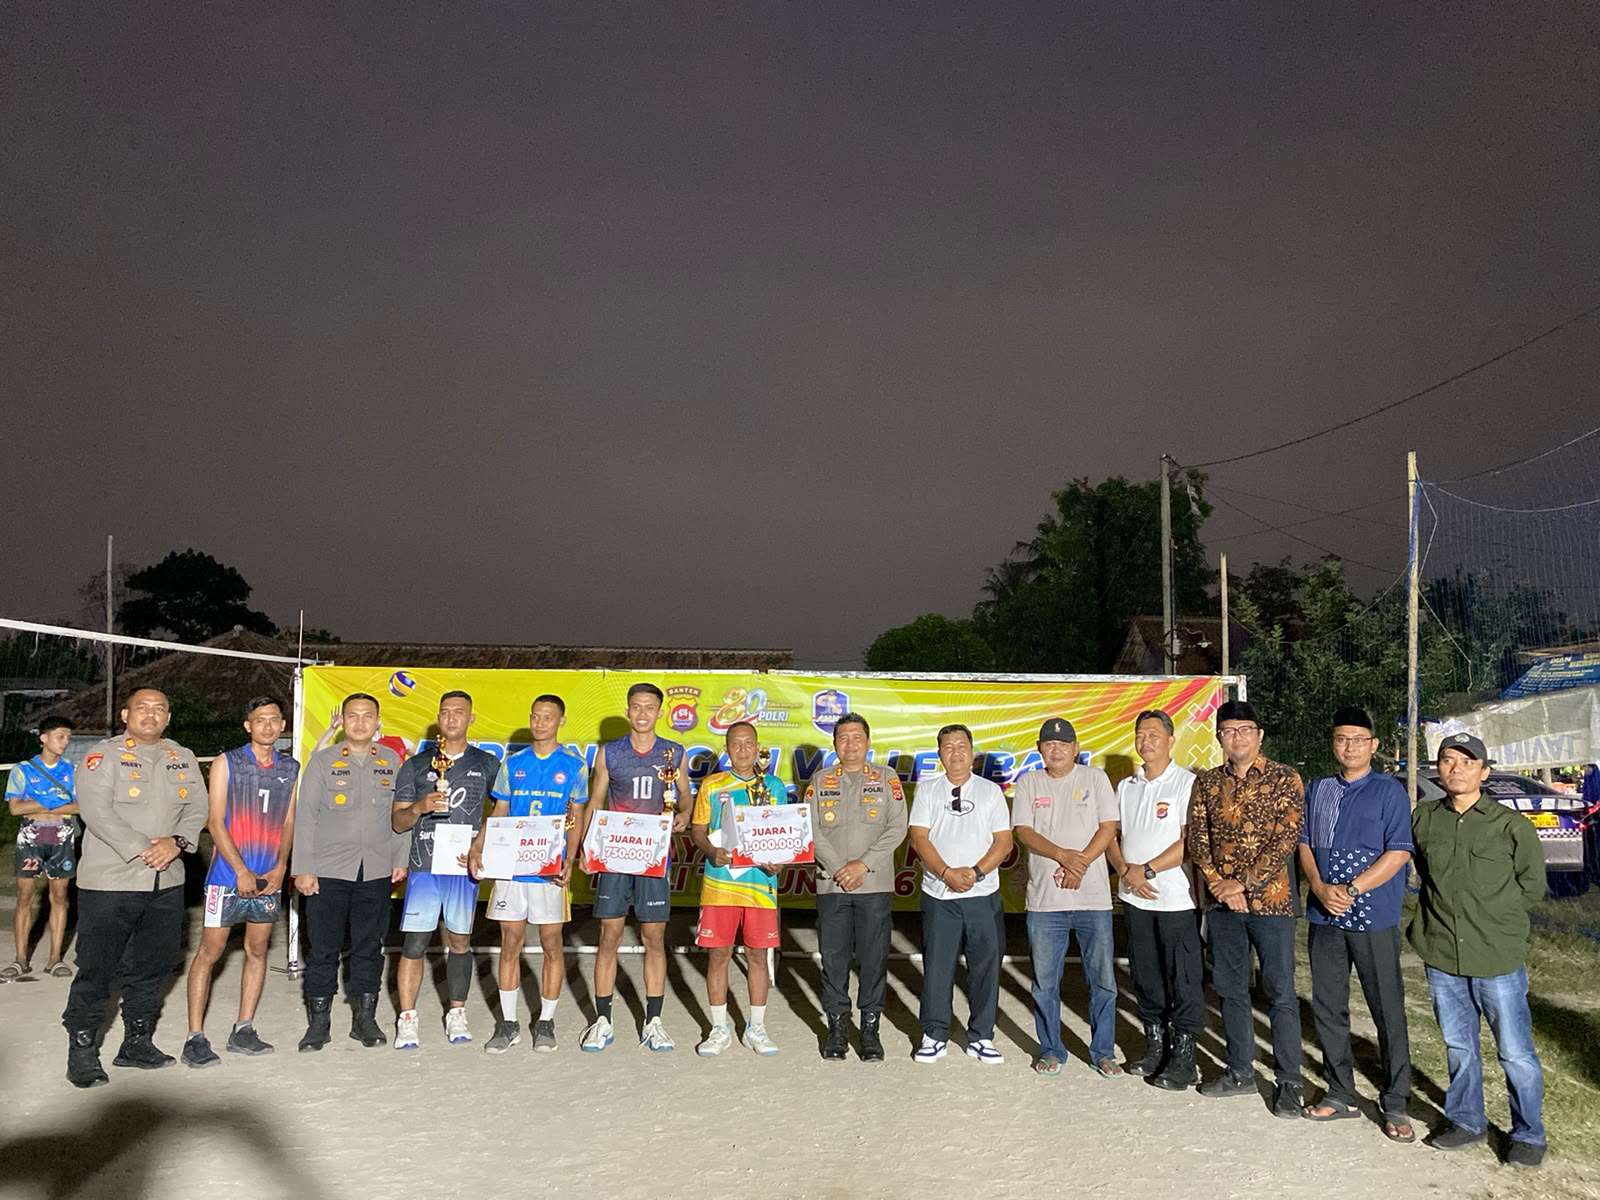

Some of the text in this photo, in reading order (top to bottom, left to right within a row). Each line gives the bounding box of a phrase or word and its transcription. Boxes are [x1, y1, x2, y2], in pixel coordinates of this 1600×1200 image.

[668, 687, 699, 696] BANTEN
[758, 711, 789, 721] POLRI
[166, 763, 189, 771] POLRI
[632, 775, 653, 800] 10
[258, 788, 270, 814] 7
[752, 826, 786, 837] JUARA
[537, 837, 547, 846] III
[609, 834, 652, 846] JUARA II
[743, 838, 802, 852] 1.000.000
[605, 847, 652, 860] 750.000
[22, 858, 40, 871] 22
